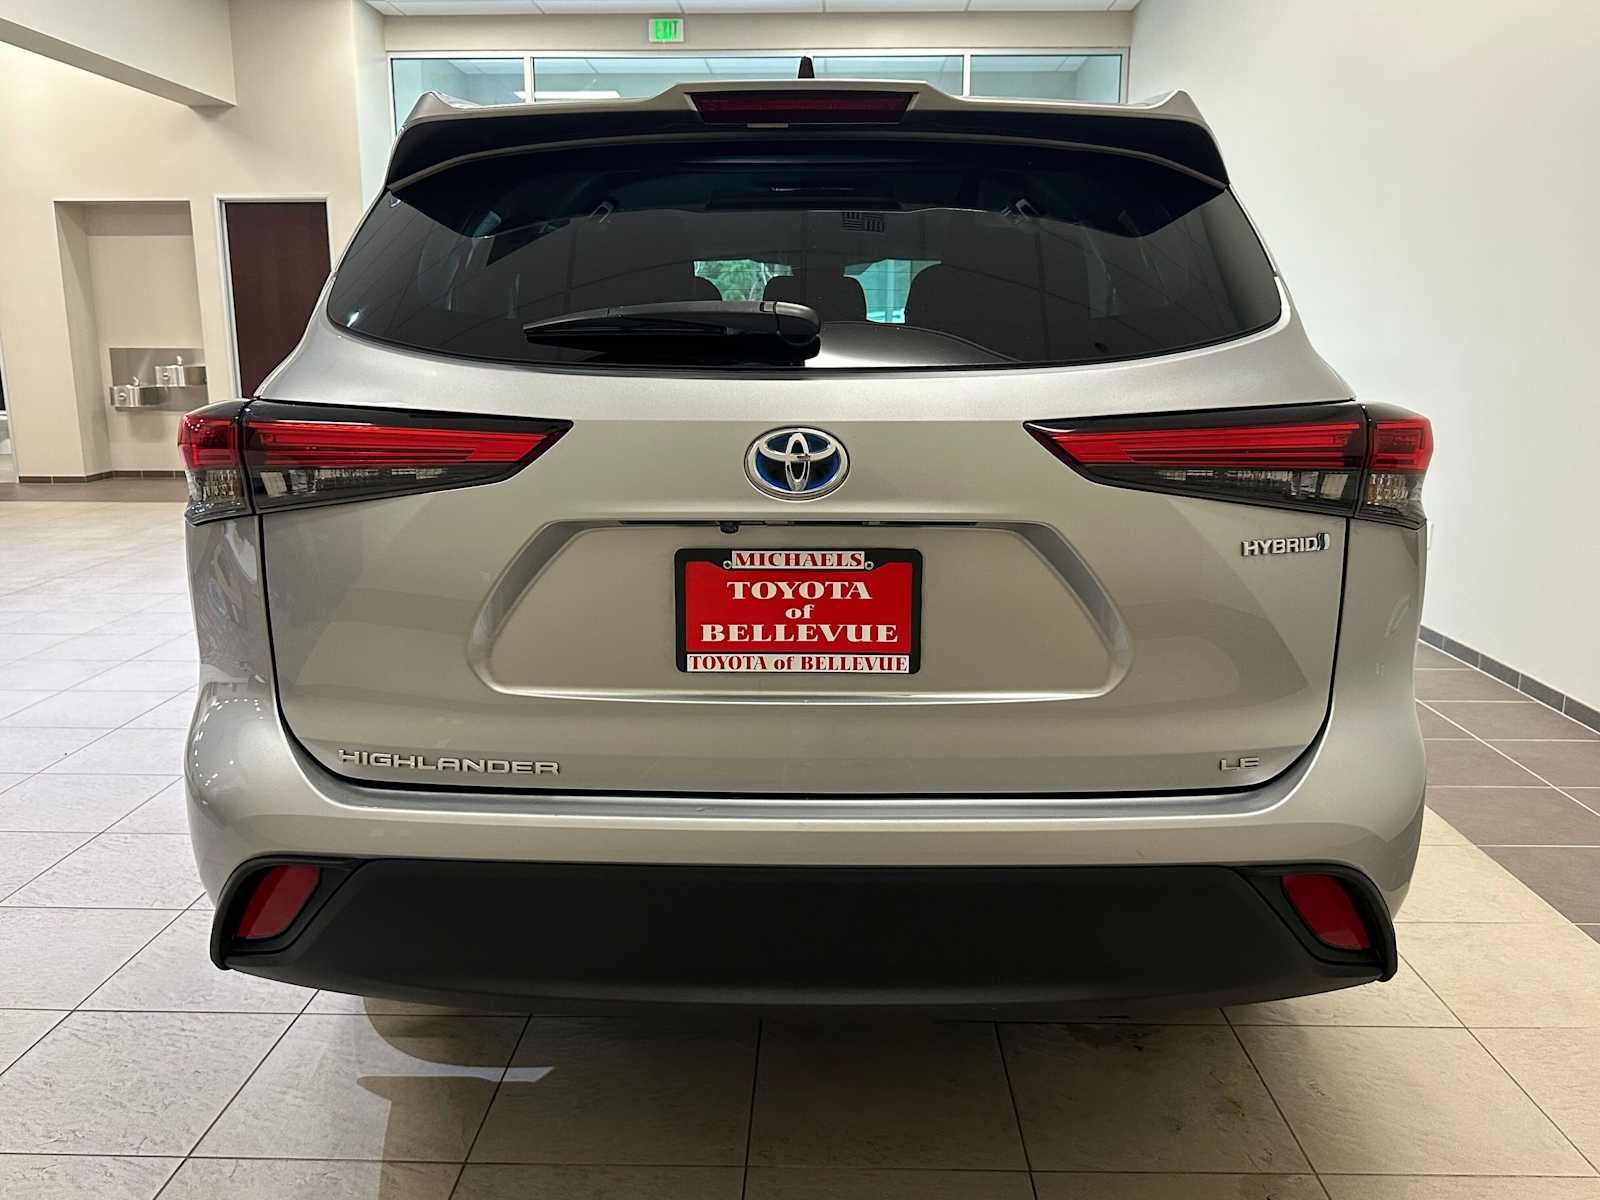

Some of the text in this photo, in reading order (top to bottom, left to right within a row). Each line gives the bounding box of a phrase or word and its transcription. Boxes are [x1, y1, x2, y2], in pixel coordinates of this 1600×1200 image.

[655, 19, 679, 40] EXIT
[1241, 537, 1318, 556] HYBRID
[735, 552, 862, 567] MICHAELS
[727, 581, 872, 600] TOYOTA
[785, 604, 815, 619] of
[701, 624, 898, 642] BELLEVUE
[689, 655, 907, 671] TOYOTA of BELLEVUE
[338, 749, 560, 776] HIGHLANDER
[1220, 757, 1259, 770] LE
